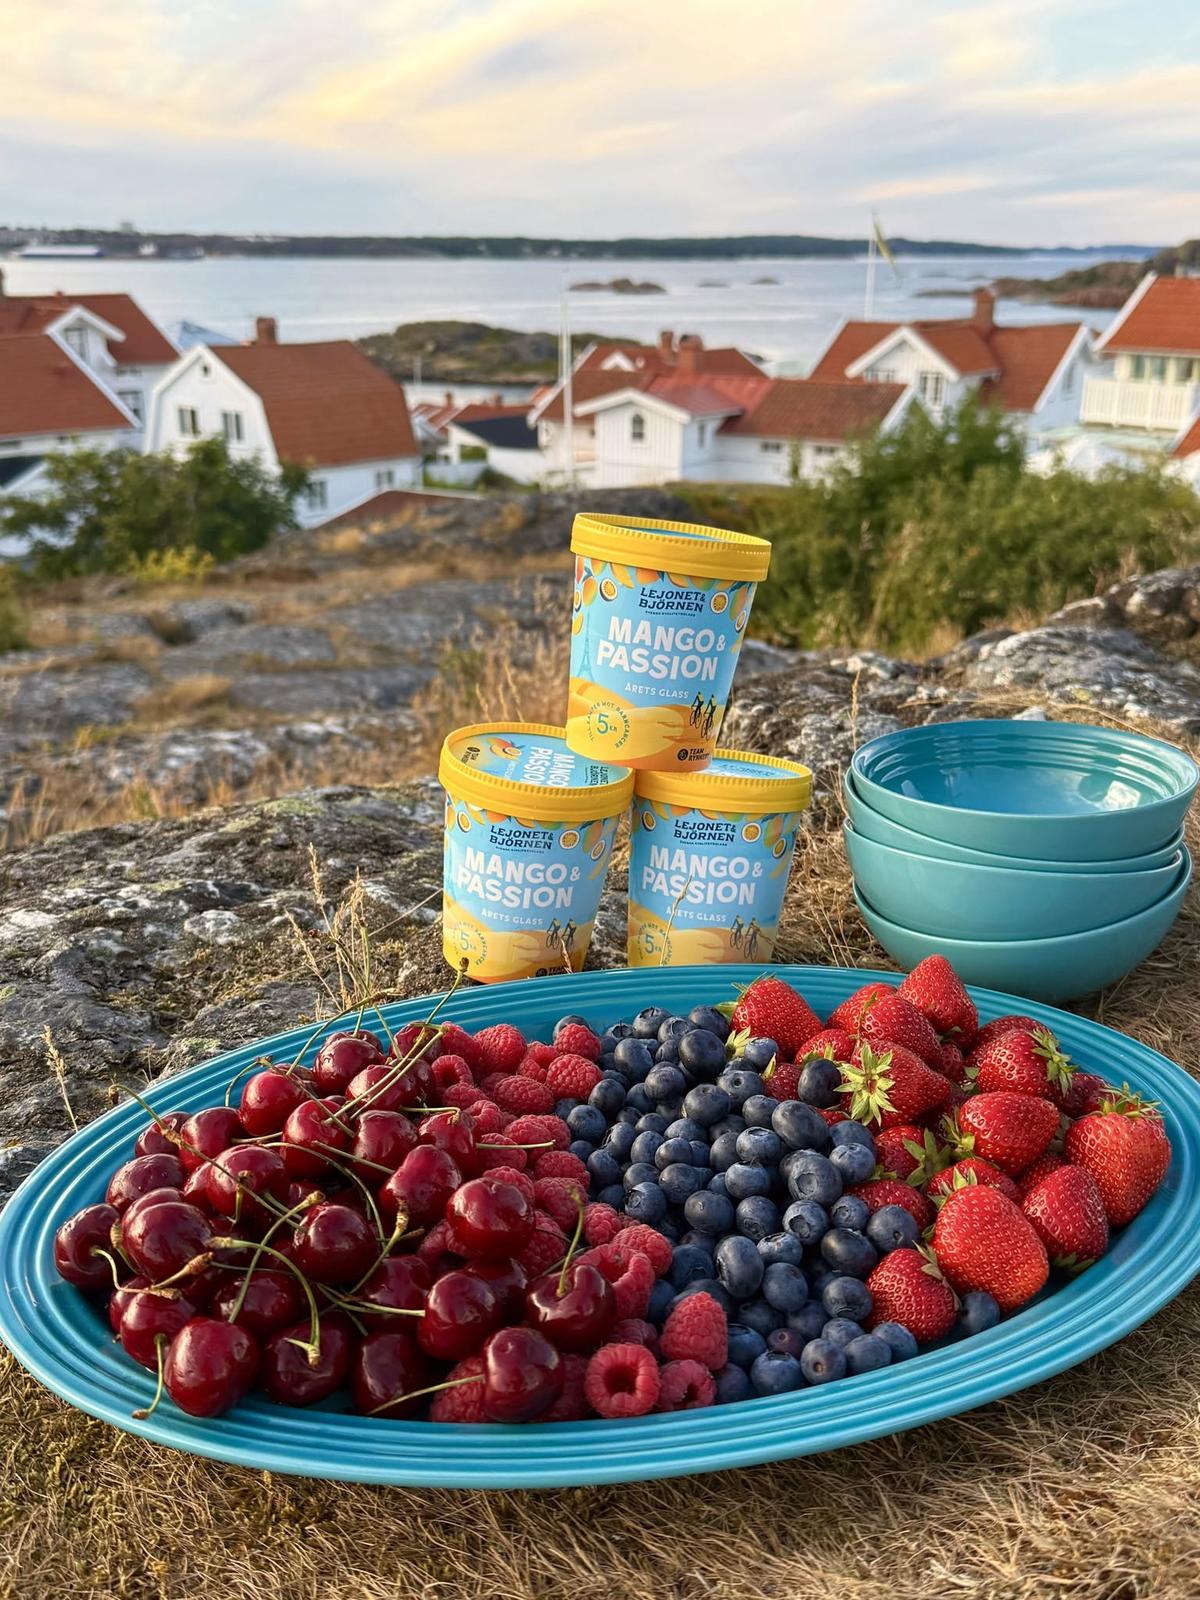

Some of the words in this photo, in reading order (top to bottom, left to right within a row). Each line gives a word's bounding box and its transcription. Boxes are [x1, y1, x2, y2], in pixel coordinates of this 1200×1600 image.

[638, 598, 704, 613] BJÖRNEN
[596, 639, 718, 681] PASSION
[624, 682, 657, 696] ÅRETS
[658, 688, 689, 699] GLASS
[596, 713, 609, 735] 5
[547, 752, 576, 787] MANGO
[489, 834, 552, 850] BJÖRNEN
[673, 828, 735, 843] BJÖRNEN
[457, 863, 574, 909] PASSION
[642, 865, 757, 906] PASSION
[480, 907, 509, 922] ÅRETS
[512, 916, 544, 926] GLASS
[665, 906, 694, 920] ÅETS
[696, 912, 727, 923] GLASS
[459, 931, 469, 951] 5
[644, 933, 655, 954] 5
